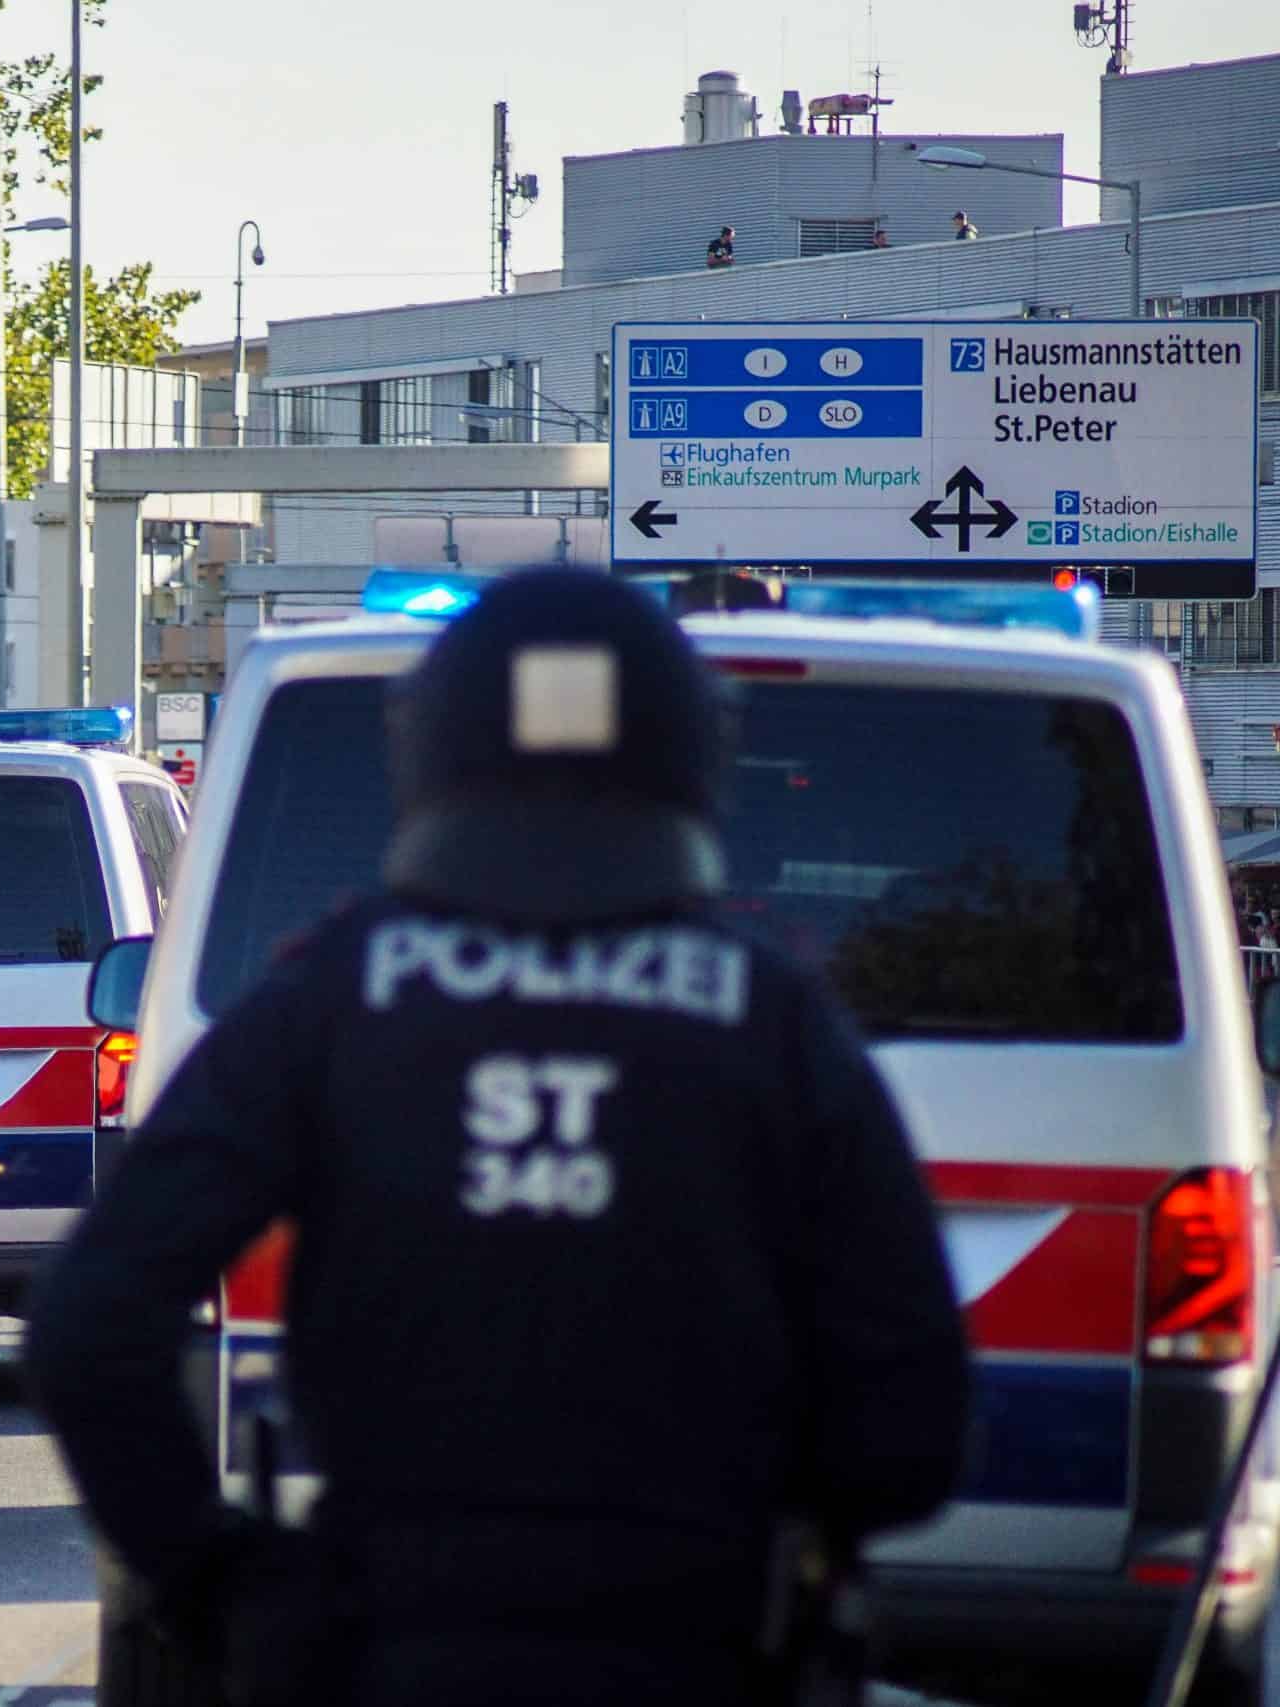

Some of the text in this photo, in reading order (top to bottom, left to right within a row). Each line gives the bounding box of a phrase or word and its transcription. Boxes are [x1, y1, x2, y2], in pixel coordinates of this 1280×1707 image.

[664, 351, 685, 375] A2
[835, 355, 848, 370] H
[951, 335, 1241, 369] 73 Hausmannstätten
[994, 374, 1137, 403] Liebenau
[663, 402, 857, 427] A9 D SLO
[994, 414, 1118, 442] St.Peter
[687, 443, 791, 465] Flughafen
[687, 467, 837, 487] Einkaufszentrum
[844, 467, 921, 489] Murpark
[1082, 496, 1158, 515] Stadion
[1081, 523, 1238, 543] Stadion/Eishalle
[160, 696, 201, 713] BSC
[366, 918, 748, 1025] POLIZEI
[465, 1057, 619, 1149] ST
[462, 1150, 616, 1219] 340
